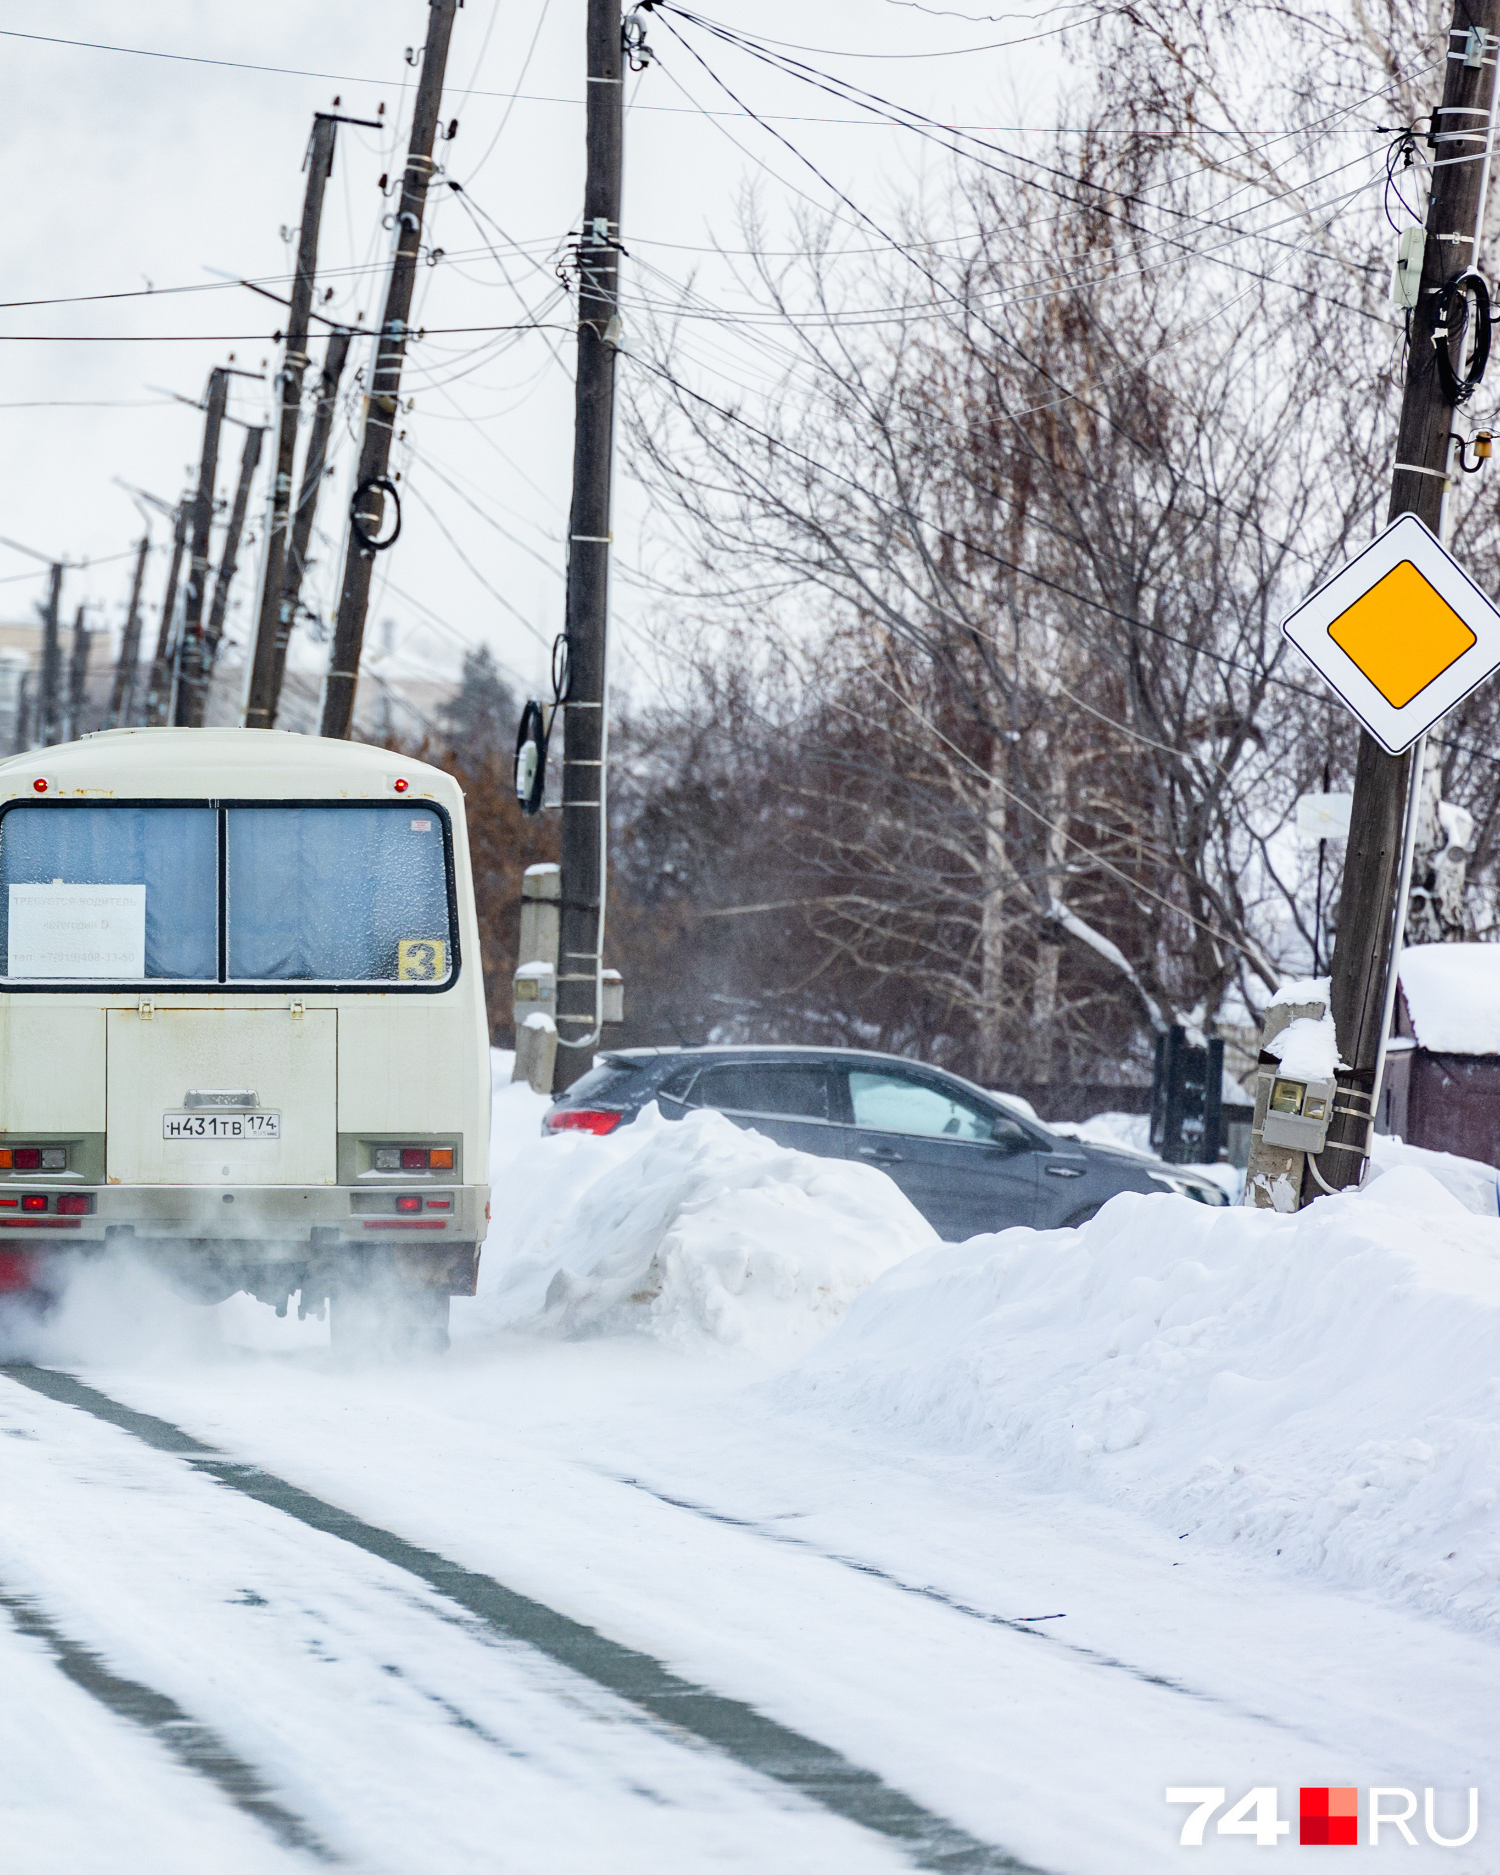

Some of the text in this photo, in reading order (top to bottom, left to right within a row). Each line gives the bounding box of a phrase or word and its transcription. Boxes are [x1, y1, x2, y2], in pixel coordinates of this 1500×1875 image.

[78, 897, 137, 907] ВОДИТЕЛЬ
[405, 943, 436, 980] 3
[170, 1116, 275, 1136] Н431ТВ 174
